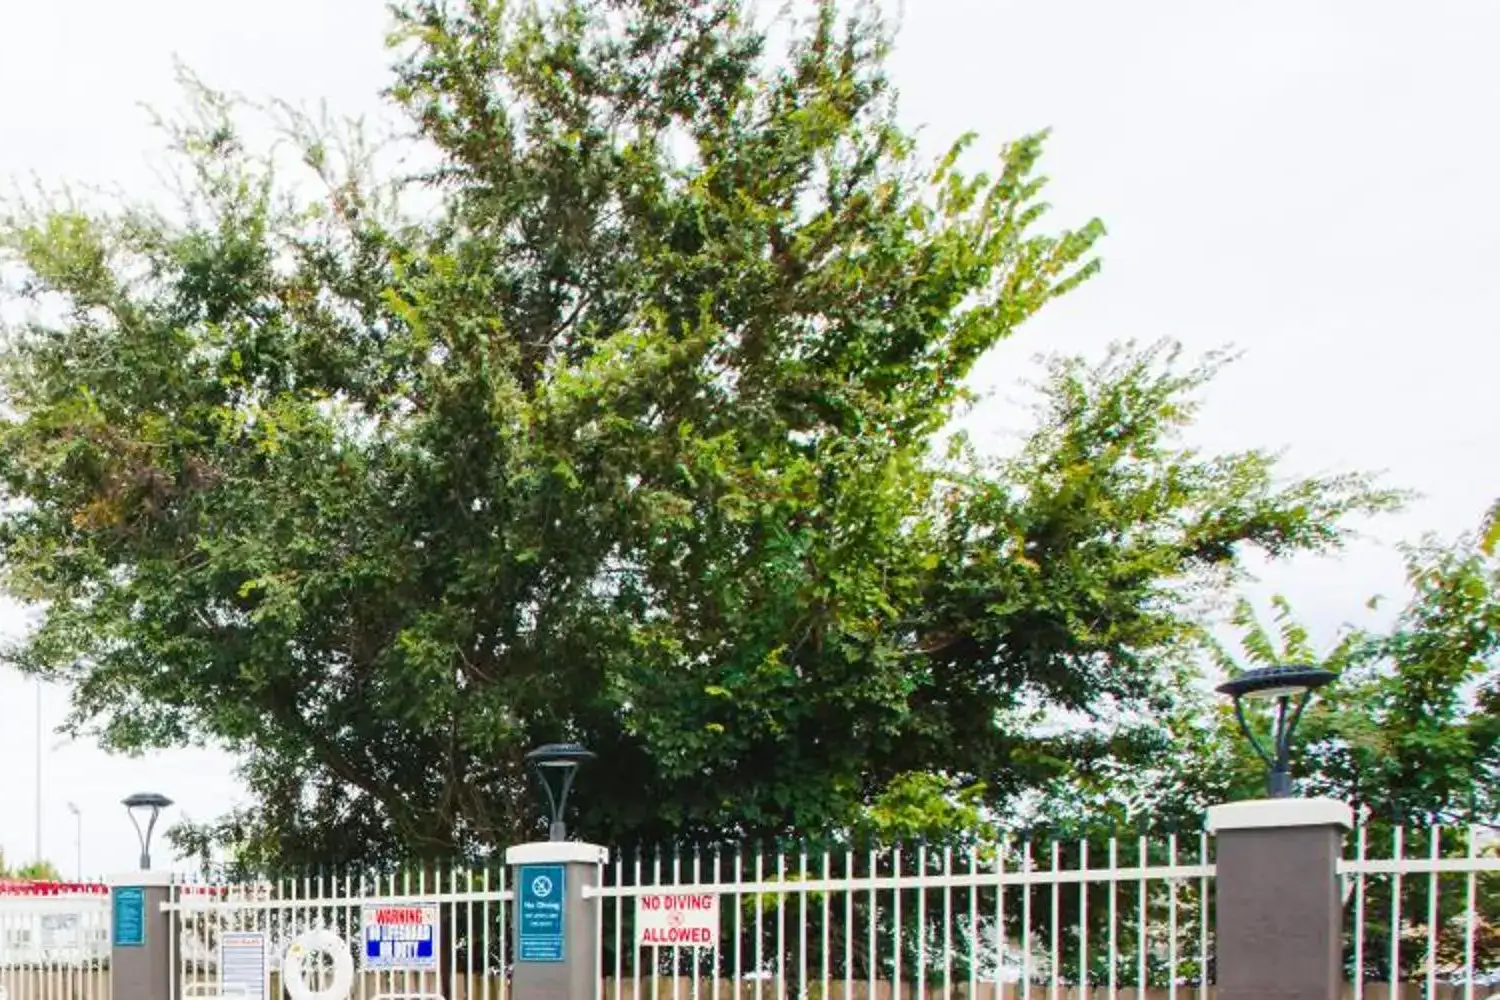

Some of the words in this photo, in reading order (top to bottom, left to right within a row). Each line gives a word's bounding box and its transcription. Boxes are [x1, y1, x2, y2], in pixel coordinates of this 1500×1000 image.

[641, 896, 661, 910] NO
[664, 895, 712, 910] DIVING
[376, 908, 422, 924] WARNING
[643, 927, 711, 943] ALLOWED
